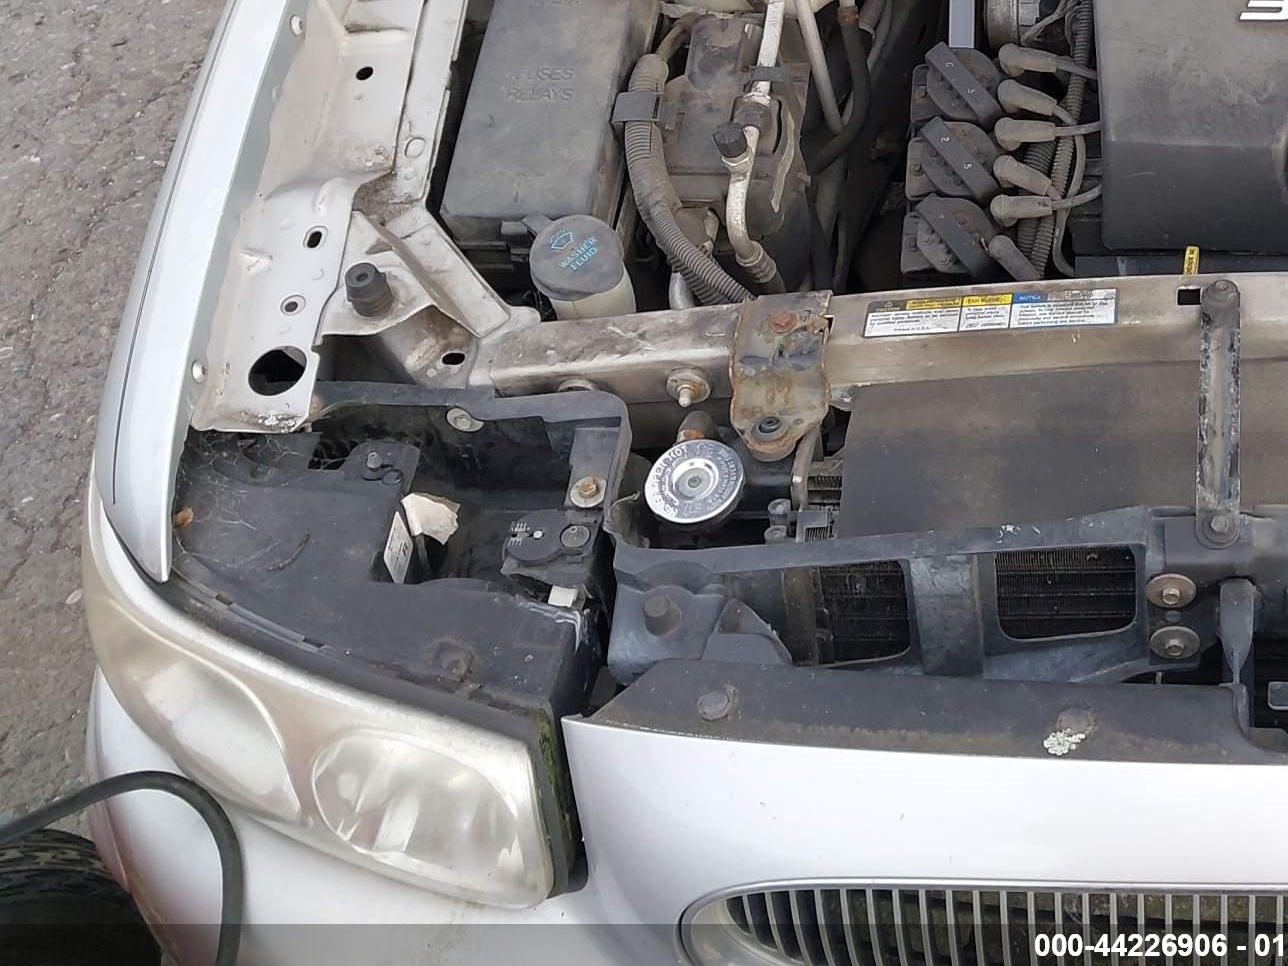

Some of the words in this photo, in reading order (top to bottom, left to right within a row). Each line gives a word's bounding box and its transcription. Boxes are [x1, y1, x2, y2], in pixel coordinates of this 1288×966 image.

[519, 66, 575, 81] FUSES
[506, 87, 575, 101] RELAYS
[559, 235, 599, 269] WASHER
[570, 247, 599, 271] FLUID
